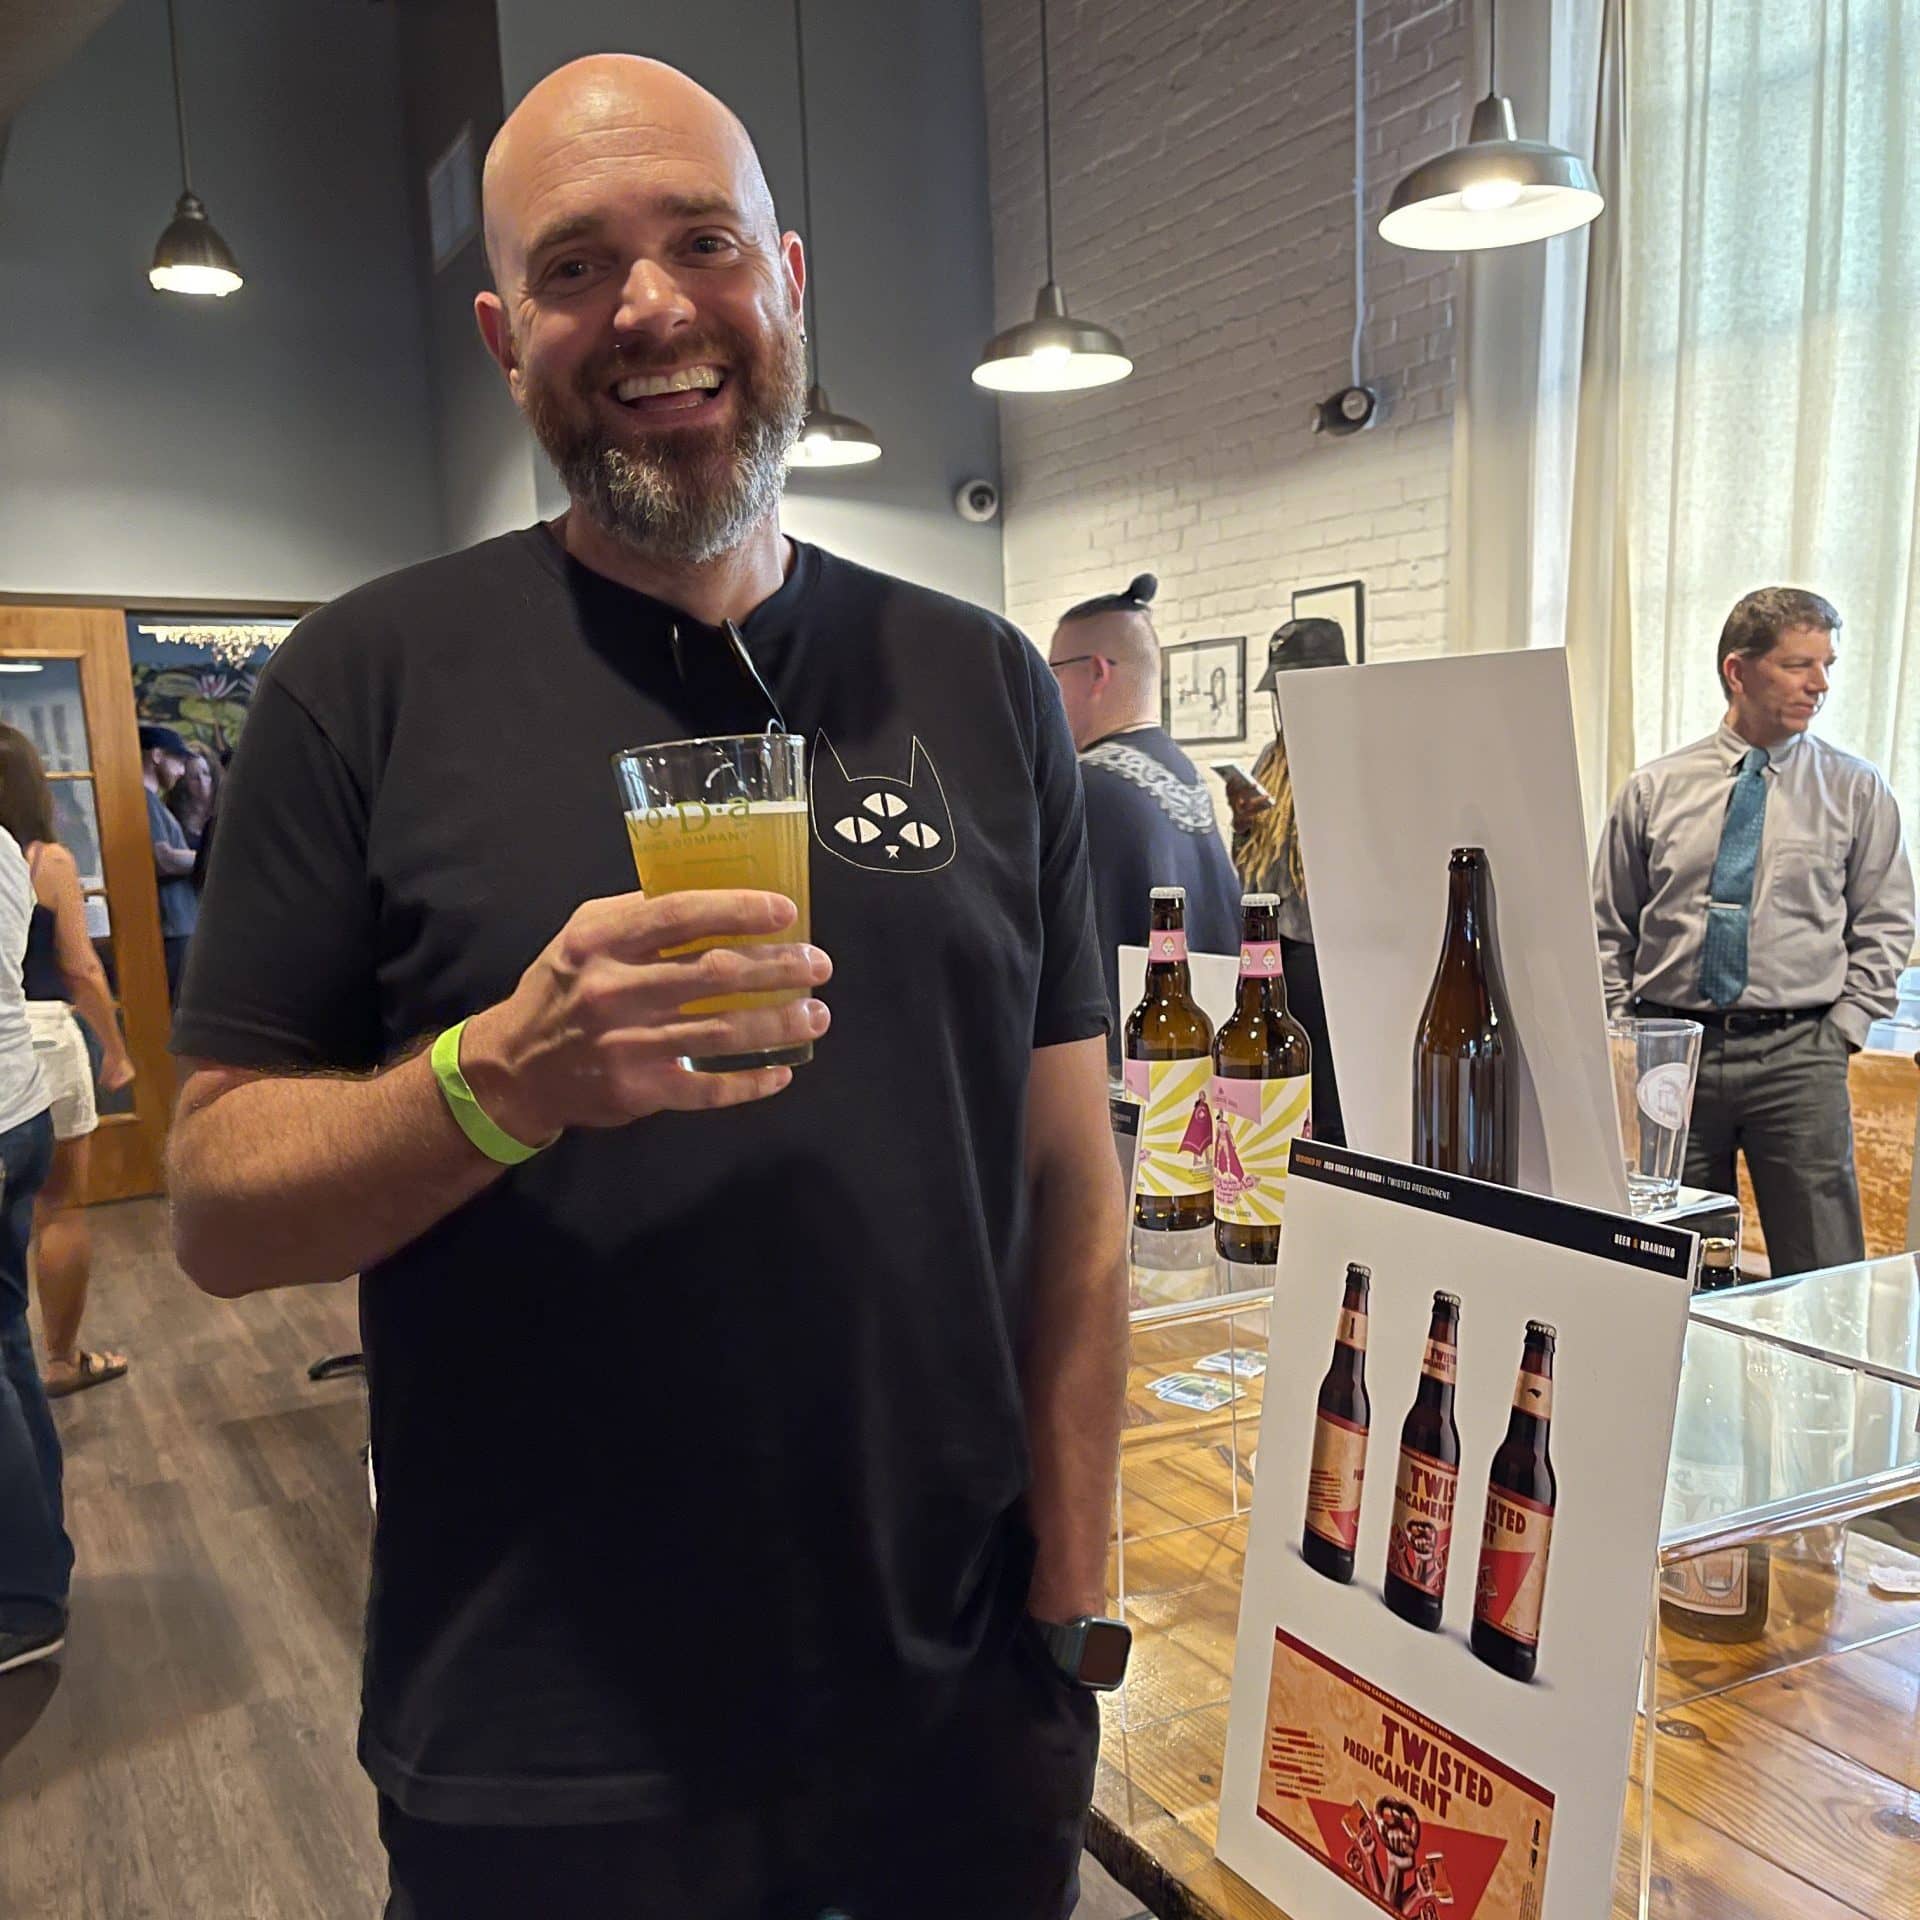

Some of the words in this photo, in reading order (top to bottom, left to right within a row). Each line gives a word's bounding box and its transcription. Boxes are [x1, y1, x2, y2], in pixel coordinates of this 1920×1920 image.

[1387, 1176, 1411, 1191] TWISTED
[1614, 1233, 1631, 1248] BEER
[1640, 1240, 1676, 1260] BRANDING
[1343, 1735, 1452, 1819] PREDICAMENT
[1382, 1713, 1494, 1808] TWISTED
